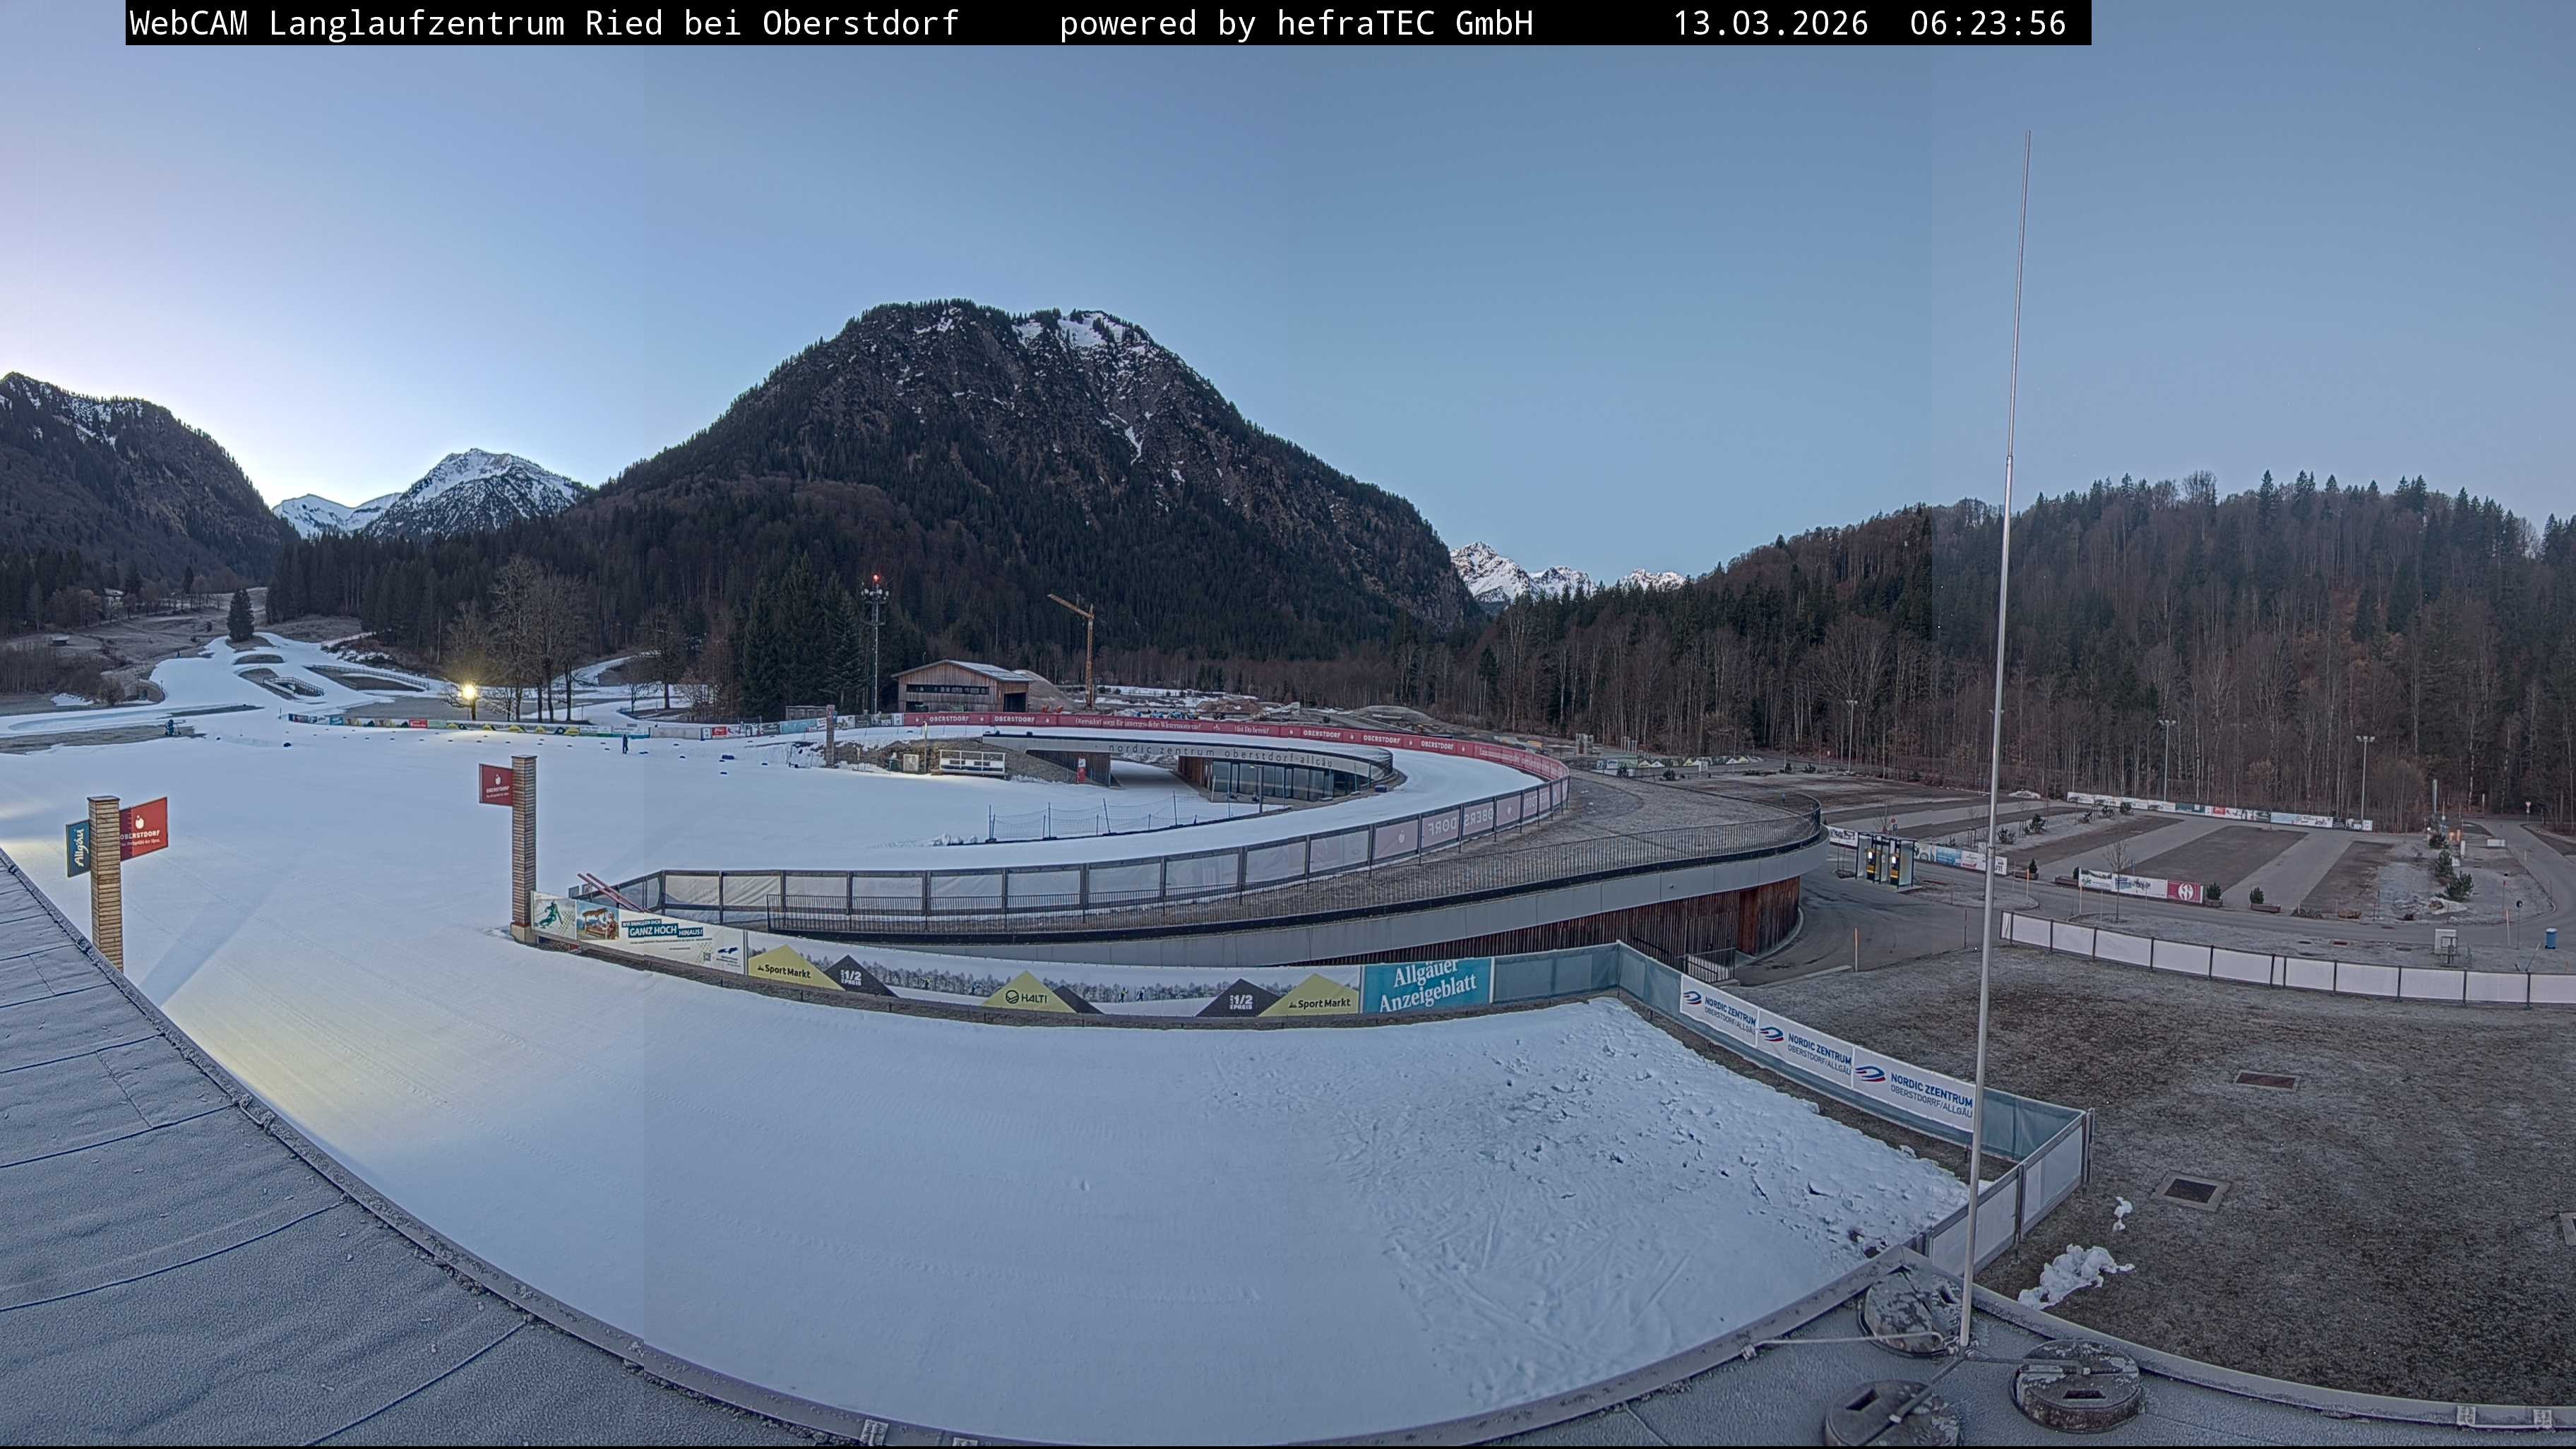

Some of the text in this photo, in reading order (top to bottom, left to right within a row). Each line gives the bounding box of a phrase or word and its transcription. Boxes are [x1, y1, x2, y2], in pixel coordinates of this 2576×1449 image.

[1303, 730, 1341, 739] OBERSTDORF
[1363, 734, 1401, 744] OBERSTDORF
[1109, 744, 1152, 753] nordic
[1159, 747, 1215, 756] zentrum
[1421, 741, 1455, 750] OBERSTDORF
[120, 830, 160, 840] OBERSTDORF
[74, 828, 89, 867] Allgäu
[654, 925, 677, 934] HOCH
[844, 970, 861, 980] 1/2
[1393, 960, 1459, 988] Allgäuer
[1380, 973, 1477, 1013] Anzeigeblatt
[1021, 994, 1047, 1003] HALTI
[1234, 994, 1253, 1004] 1/2
[1705, 996, 1756, 1026] NORDIC ZENTRUM
[1789, 1033, 1852, 1066] NORDIC ZENTRUM
[1891, 1072, 1924, 1092] NORDIC
